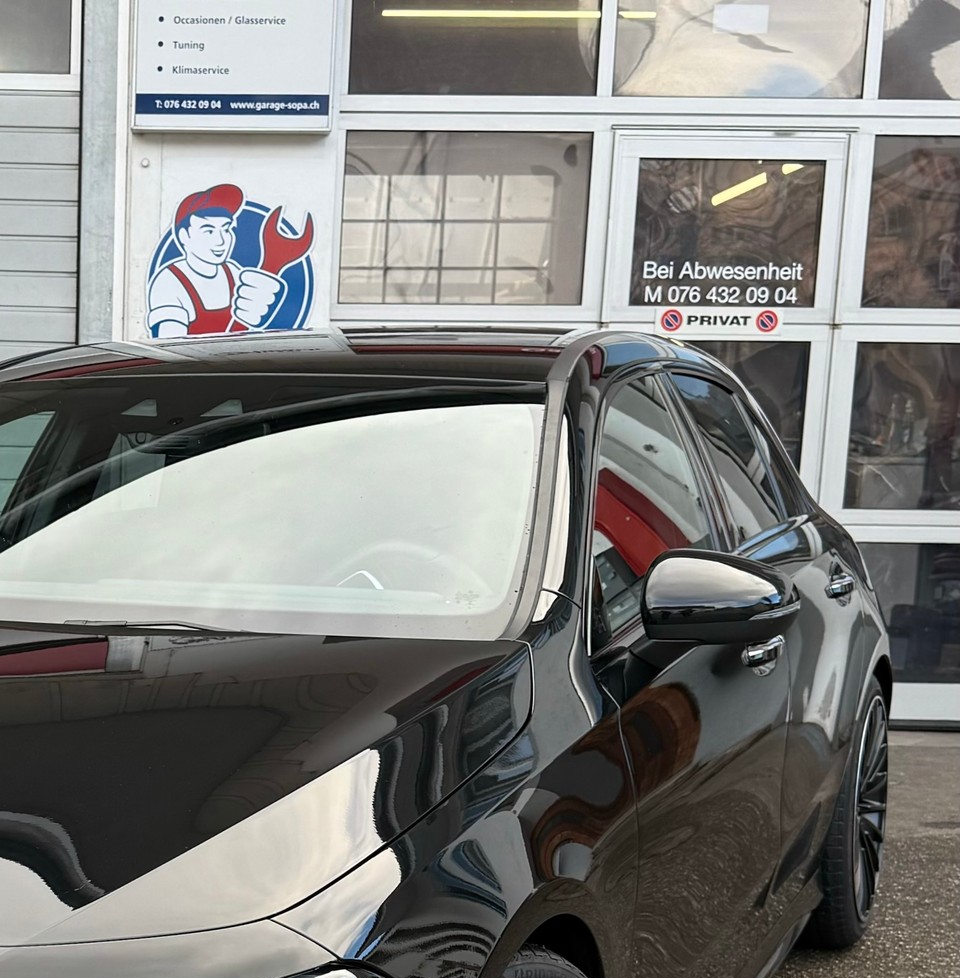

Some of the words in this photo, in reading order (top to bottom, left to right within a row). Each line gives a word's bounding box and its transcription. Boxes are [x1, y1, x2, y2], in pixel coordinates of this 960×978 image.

[173, 15, 226, 25] Occasionen
[234, 15, 287, 26] Glasservice
[172, 40, 205, 51] Tuning
[172, 65, 230, 75] Klimaservice
[154, 99, 162, 109] T:
[163, 99, 180, 109] 076
[180, 99, 197, 109] 432
[198, 100, 209, 109] 09
[210, 100, 222, 109] 04
[229, 100, 320, 112] www.garage-sopa.ch
[642, 260, 674, 279] Bei
[678, 261, 804, 281] Abwesenheit
[644, 285, 662, 303] M
[667, 286, 701, 303] 076
[705, 286, 740, 304] 432
[745, 286, 769, 304] 09
[774, 287, 798, 304] 04
[686, 315, 752, 326] PRIVAT
